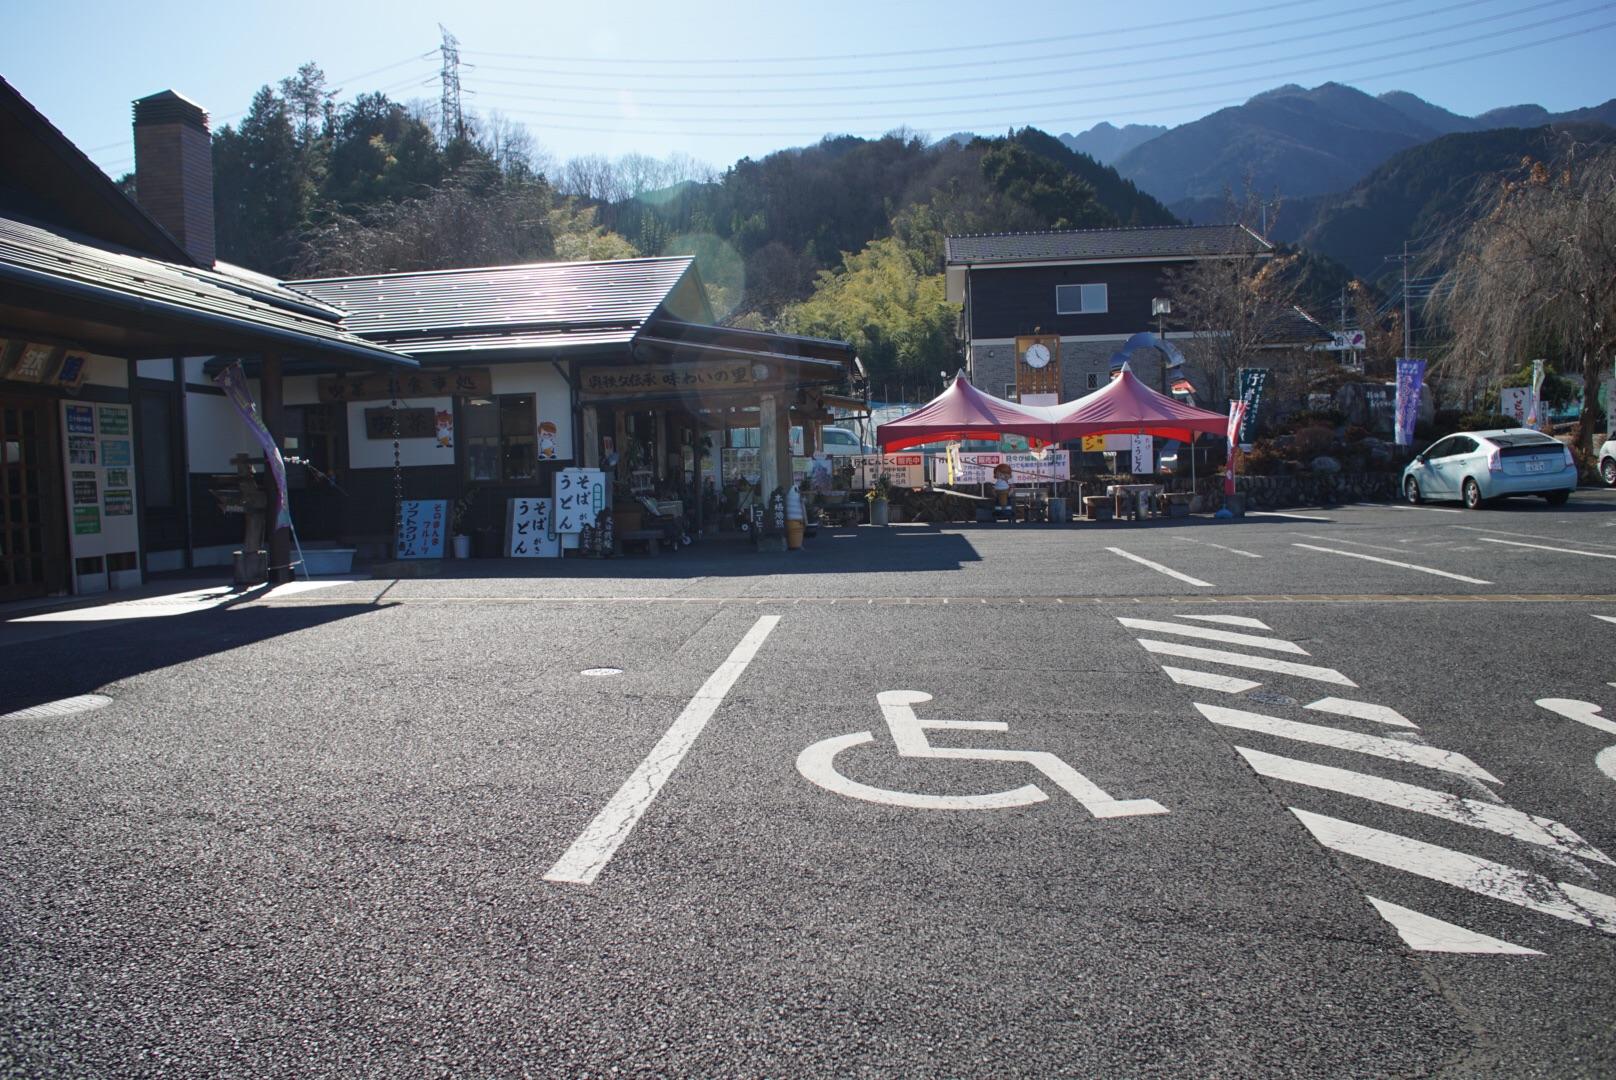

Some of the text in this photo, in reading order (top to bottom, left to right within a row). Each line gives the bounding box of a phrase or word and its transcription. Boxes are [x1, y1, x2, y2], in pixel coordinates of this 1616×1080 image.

[662, 366, 751, 387] 味わいの里
[404, 502, 419, 557] ソフトクリーム
[513, 500, 531, 554] うどん
[559, 475, 574, 530] うどん
